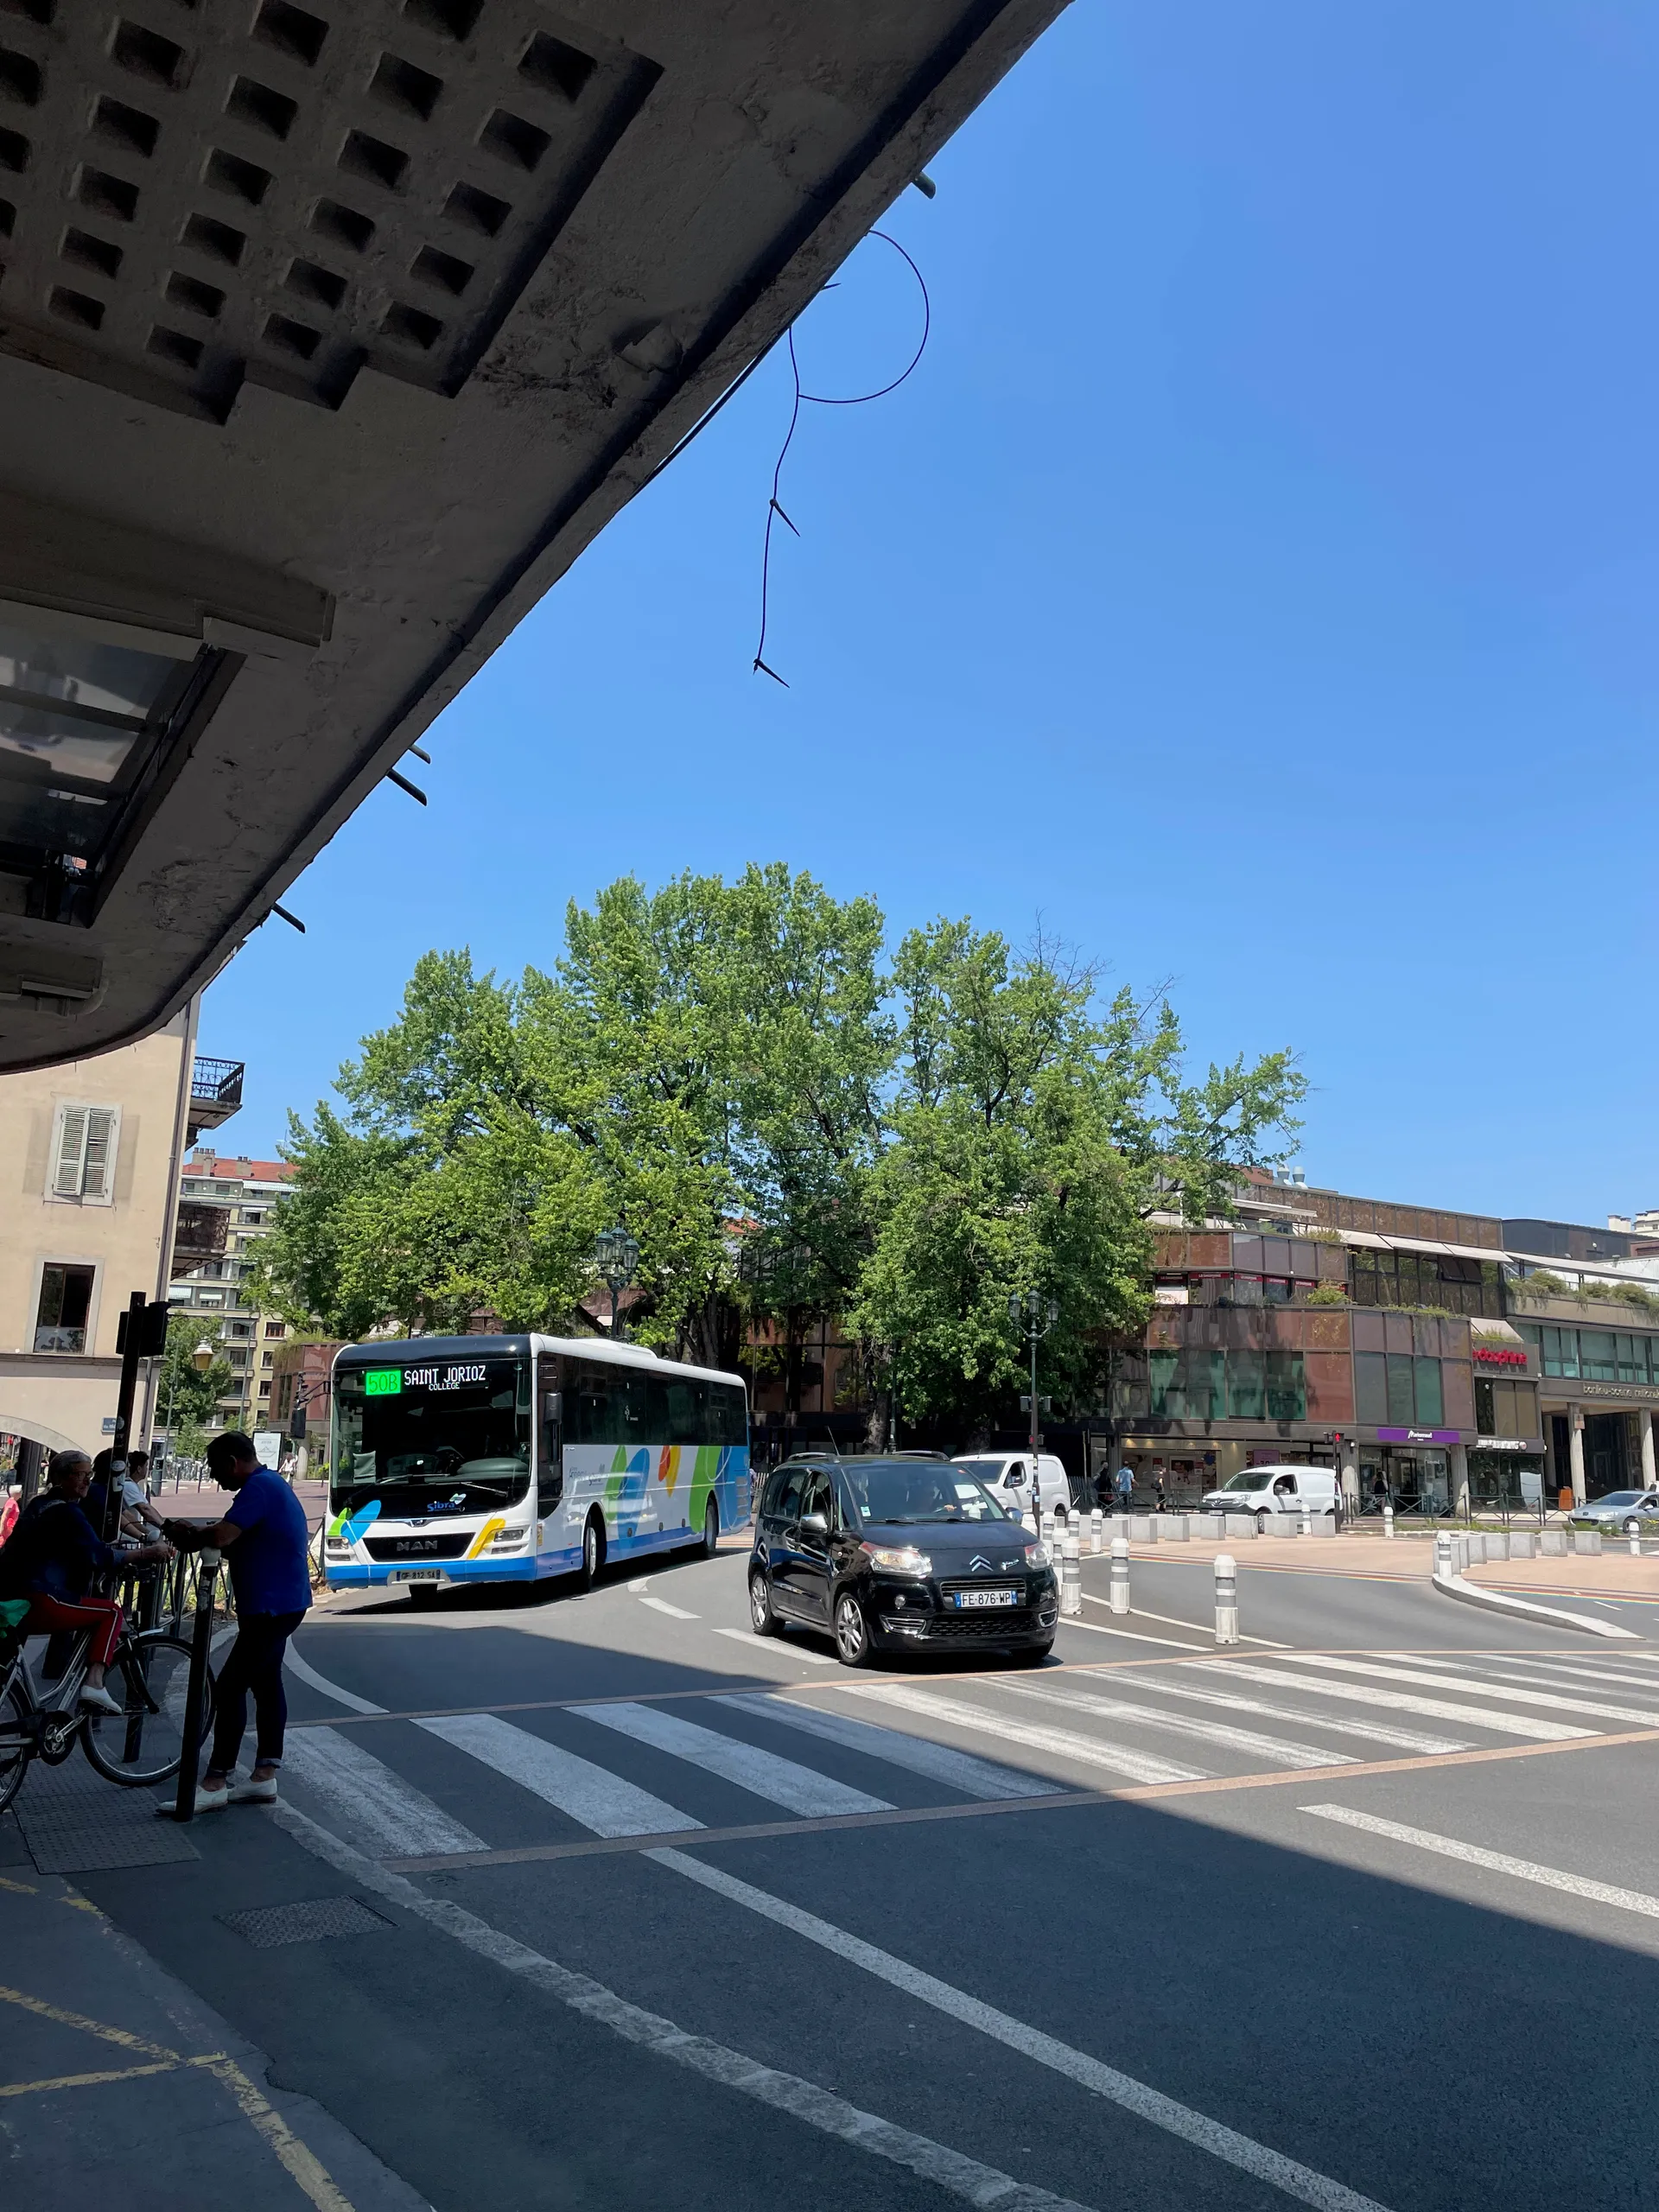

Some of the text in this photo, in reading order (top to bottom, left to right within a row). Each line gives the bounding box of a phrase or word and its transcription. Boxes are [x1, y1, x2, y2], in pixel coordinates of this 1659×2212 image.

[369, 1373, 397, 1393] 50B
[404, 1365, 486, 1386] SAINT JORIOZ
[397, 1540, 438, 1552] MAN
[962, 1592, 1011, 1605] FE-876-WP
